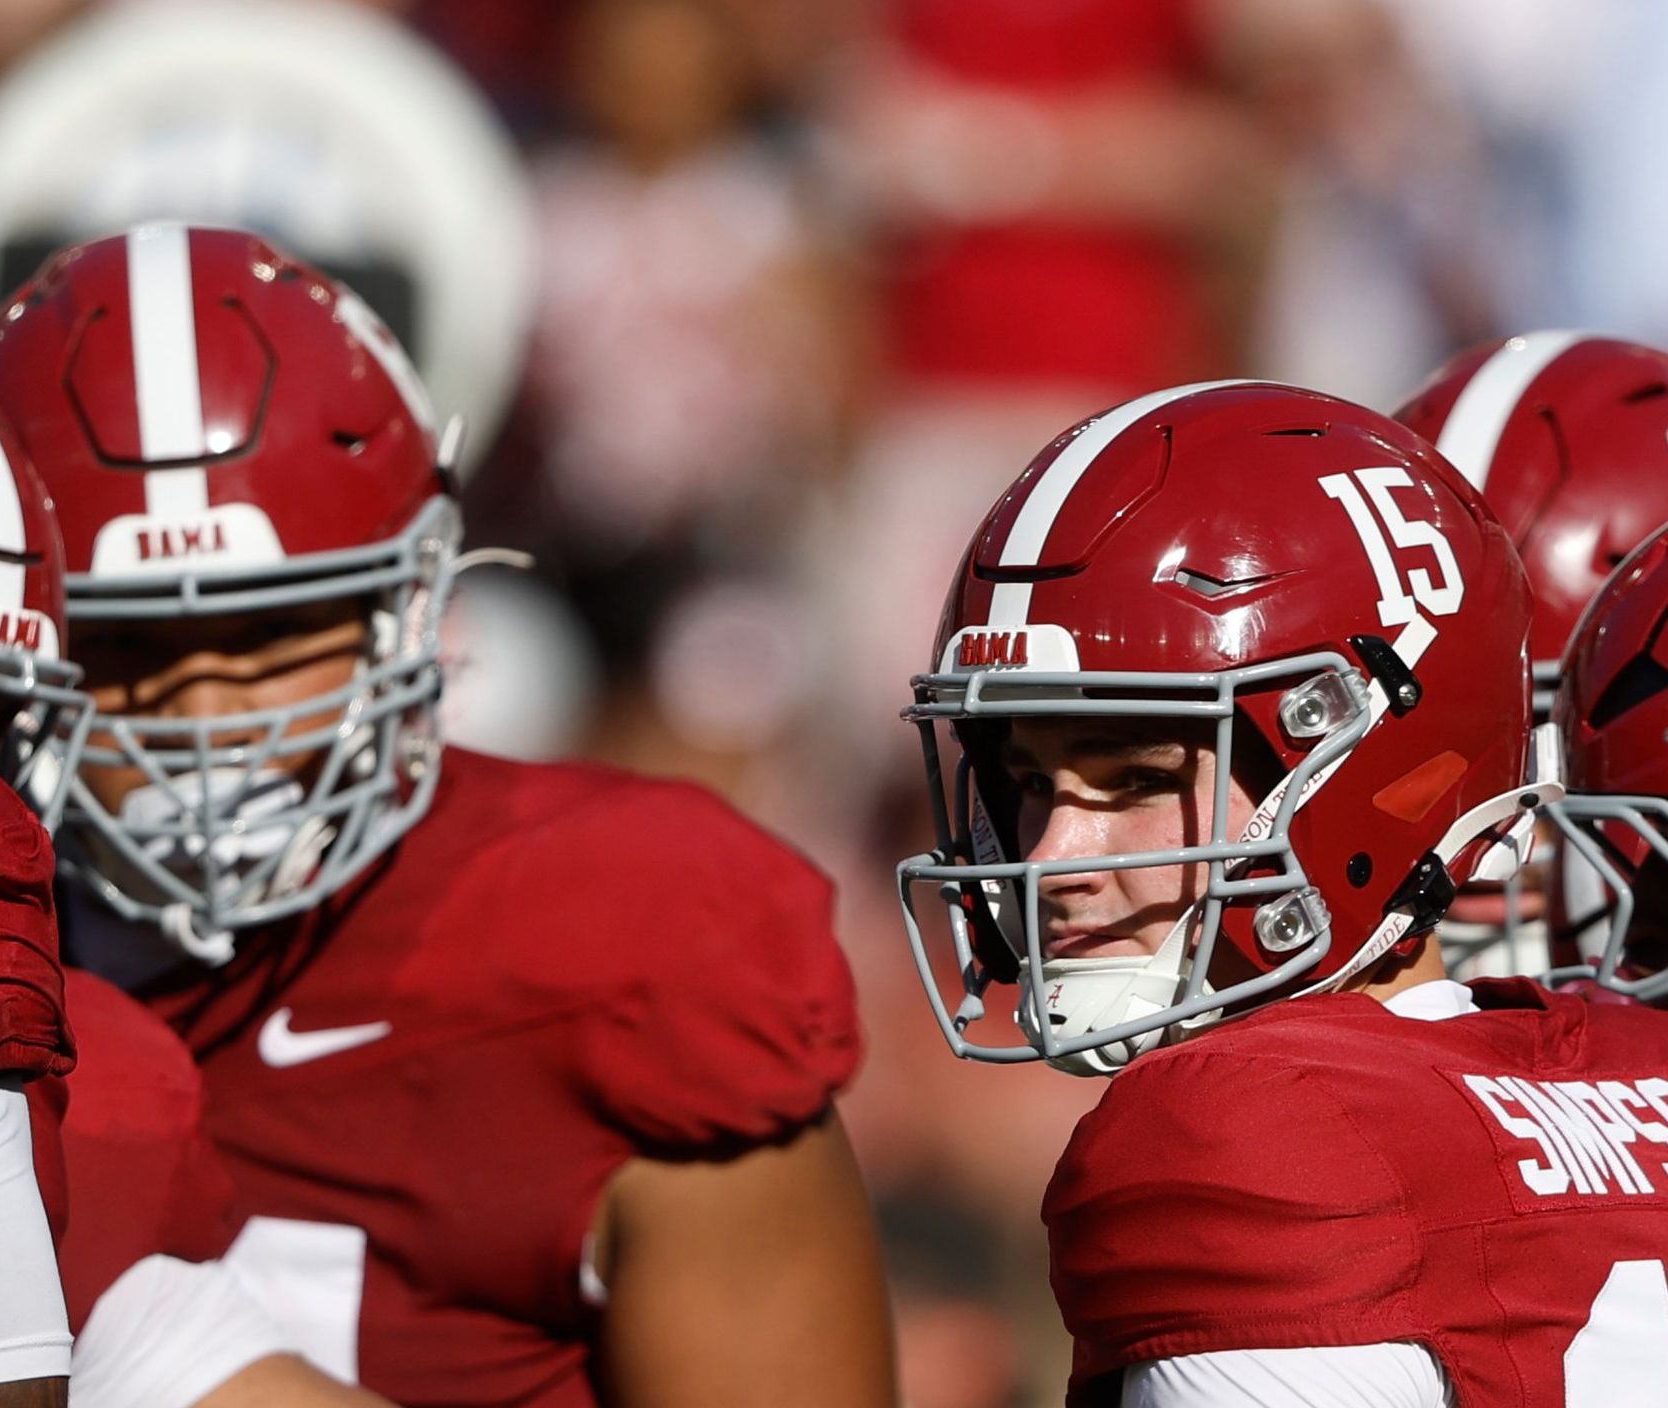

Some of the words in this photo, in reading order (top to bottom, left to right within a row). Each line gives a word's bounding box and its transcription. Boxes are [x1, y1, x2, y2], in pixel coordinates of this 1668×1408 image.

[136, 523, 227, 561] BAMA
[1317, 466, 1465, 627] 15
[958, 631, 1029, 667] BAMA
[1366, 915, 1407, 959] TIDE
